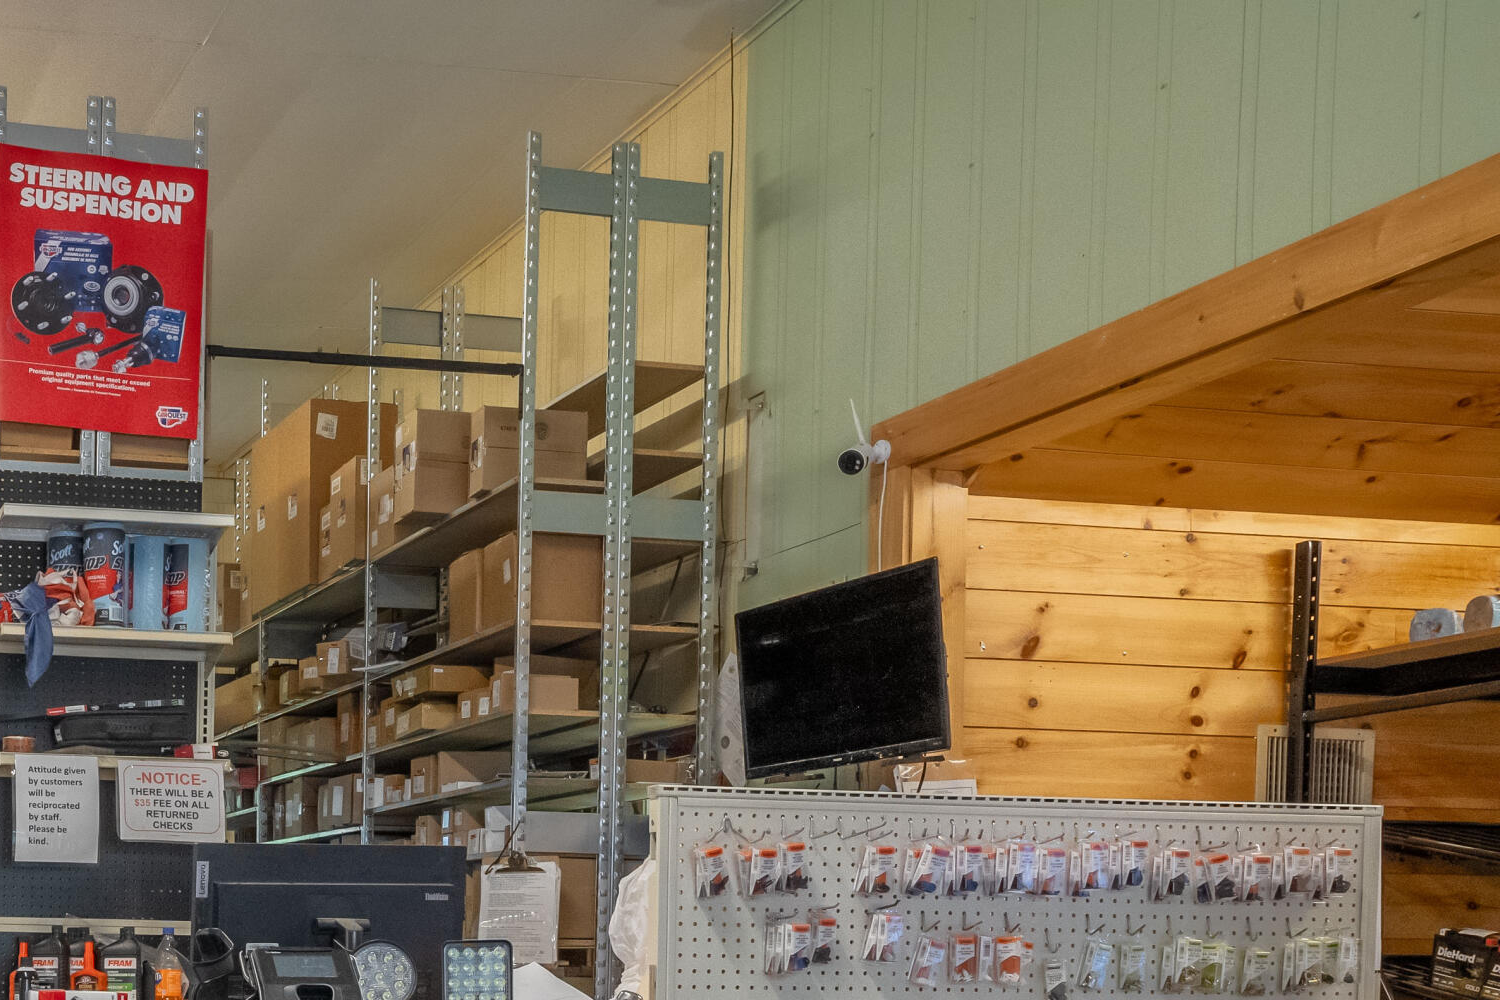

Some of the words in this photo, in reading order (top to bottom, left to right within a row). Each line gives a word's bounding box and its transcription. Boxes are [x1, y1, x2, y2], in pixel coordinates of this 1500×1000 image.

[9, 162, 132, 197] STEERING
[136, 179, 195, 203] AND
[20, 187, 182, 225] SUSPENSION
[28, 367, 54, 376] Premium
[55, 371, 75, 379] quality
[76, 373, 92, 381] parts
[92, 374, 105, 382] that
[106, 376, 121, 384] meet
[129, 379, 151, 387] exceed
[41, 375, 63, 384] original
[64, 378, 95, 388] equipment
[96, 381, 137, 393] specifications.
[50, 543, 74, 565] Scott
[27, 764, 62, 776] Attitude
[63, 766, 87, 777] given
[28, 777, 38, 788] by
[39, 778, 83, 787] customers
[135, 771, 207, 787] -NOTICE-
[28, 788, 45, 798] will
[46, 788, 56, 798] be
[130, 788, 163, 798] THERE
[165, 788, 189, 798] WILL
[190, 789, 205, 799] BE
[206, 789, 214, 799] A
[28, 800, 81, 812] reciprocated
[134, 798, 152, 808] $35
[153, 799, 174, 809] FEE
[175, 799, 190, 809] ON
[192, 800, 211, 810] ALL
[28, 811, 38, 822] by
[39, 812, 62, 822] staff.
[145, 809, 200, 821] RETURNED
[28, 824, 55, 834] Please
[56, 824, 68, 834] be
[152, 821, 194, 831] CHECKS
[28, 836, 49, 846] kind.
[199, 864, 207, 895] Lenovo
[1437, 946, 1476, 964] DieHard
[107, 959, 133, 967] FRAM
[1464, 983, 1481, 993] GOLD
